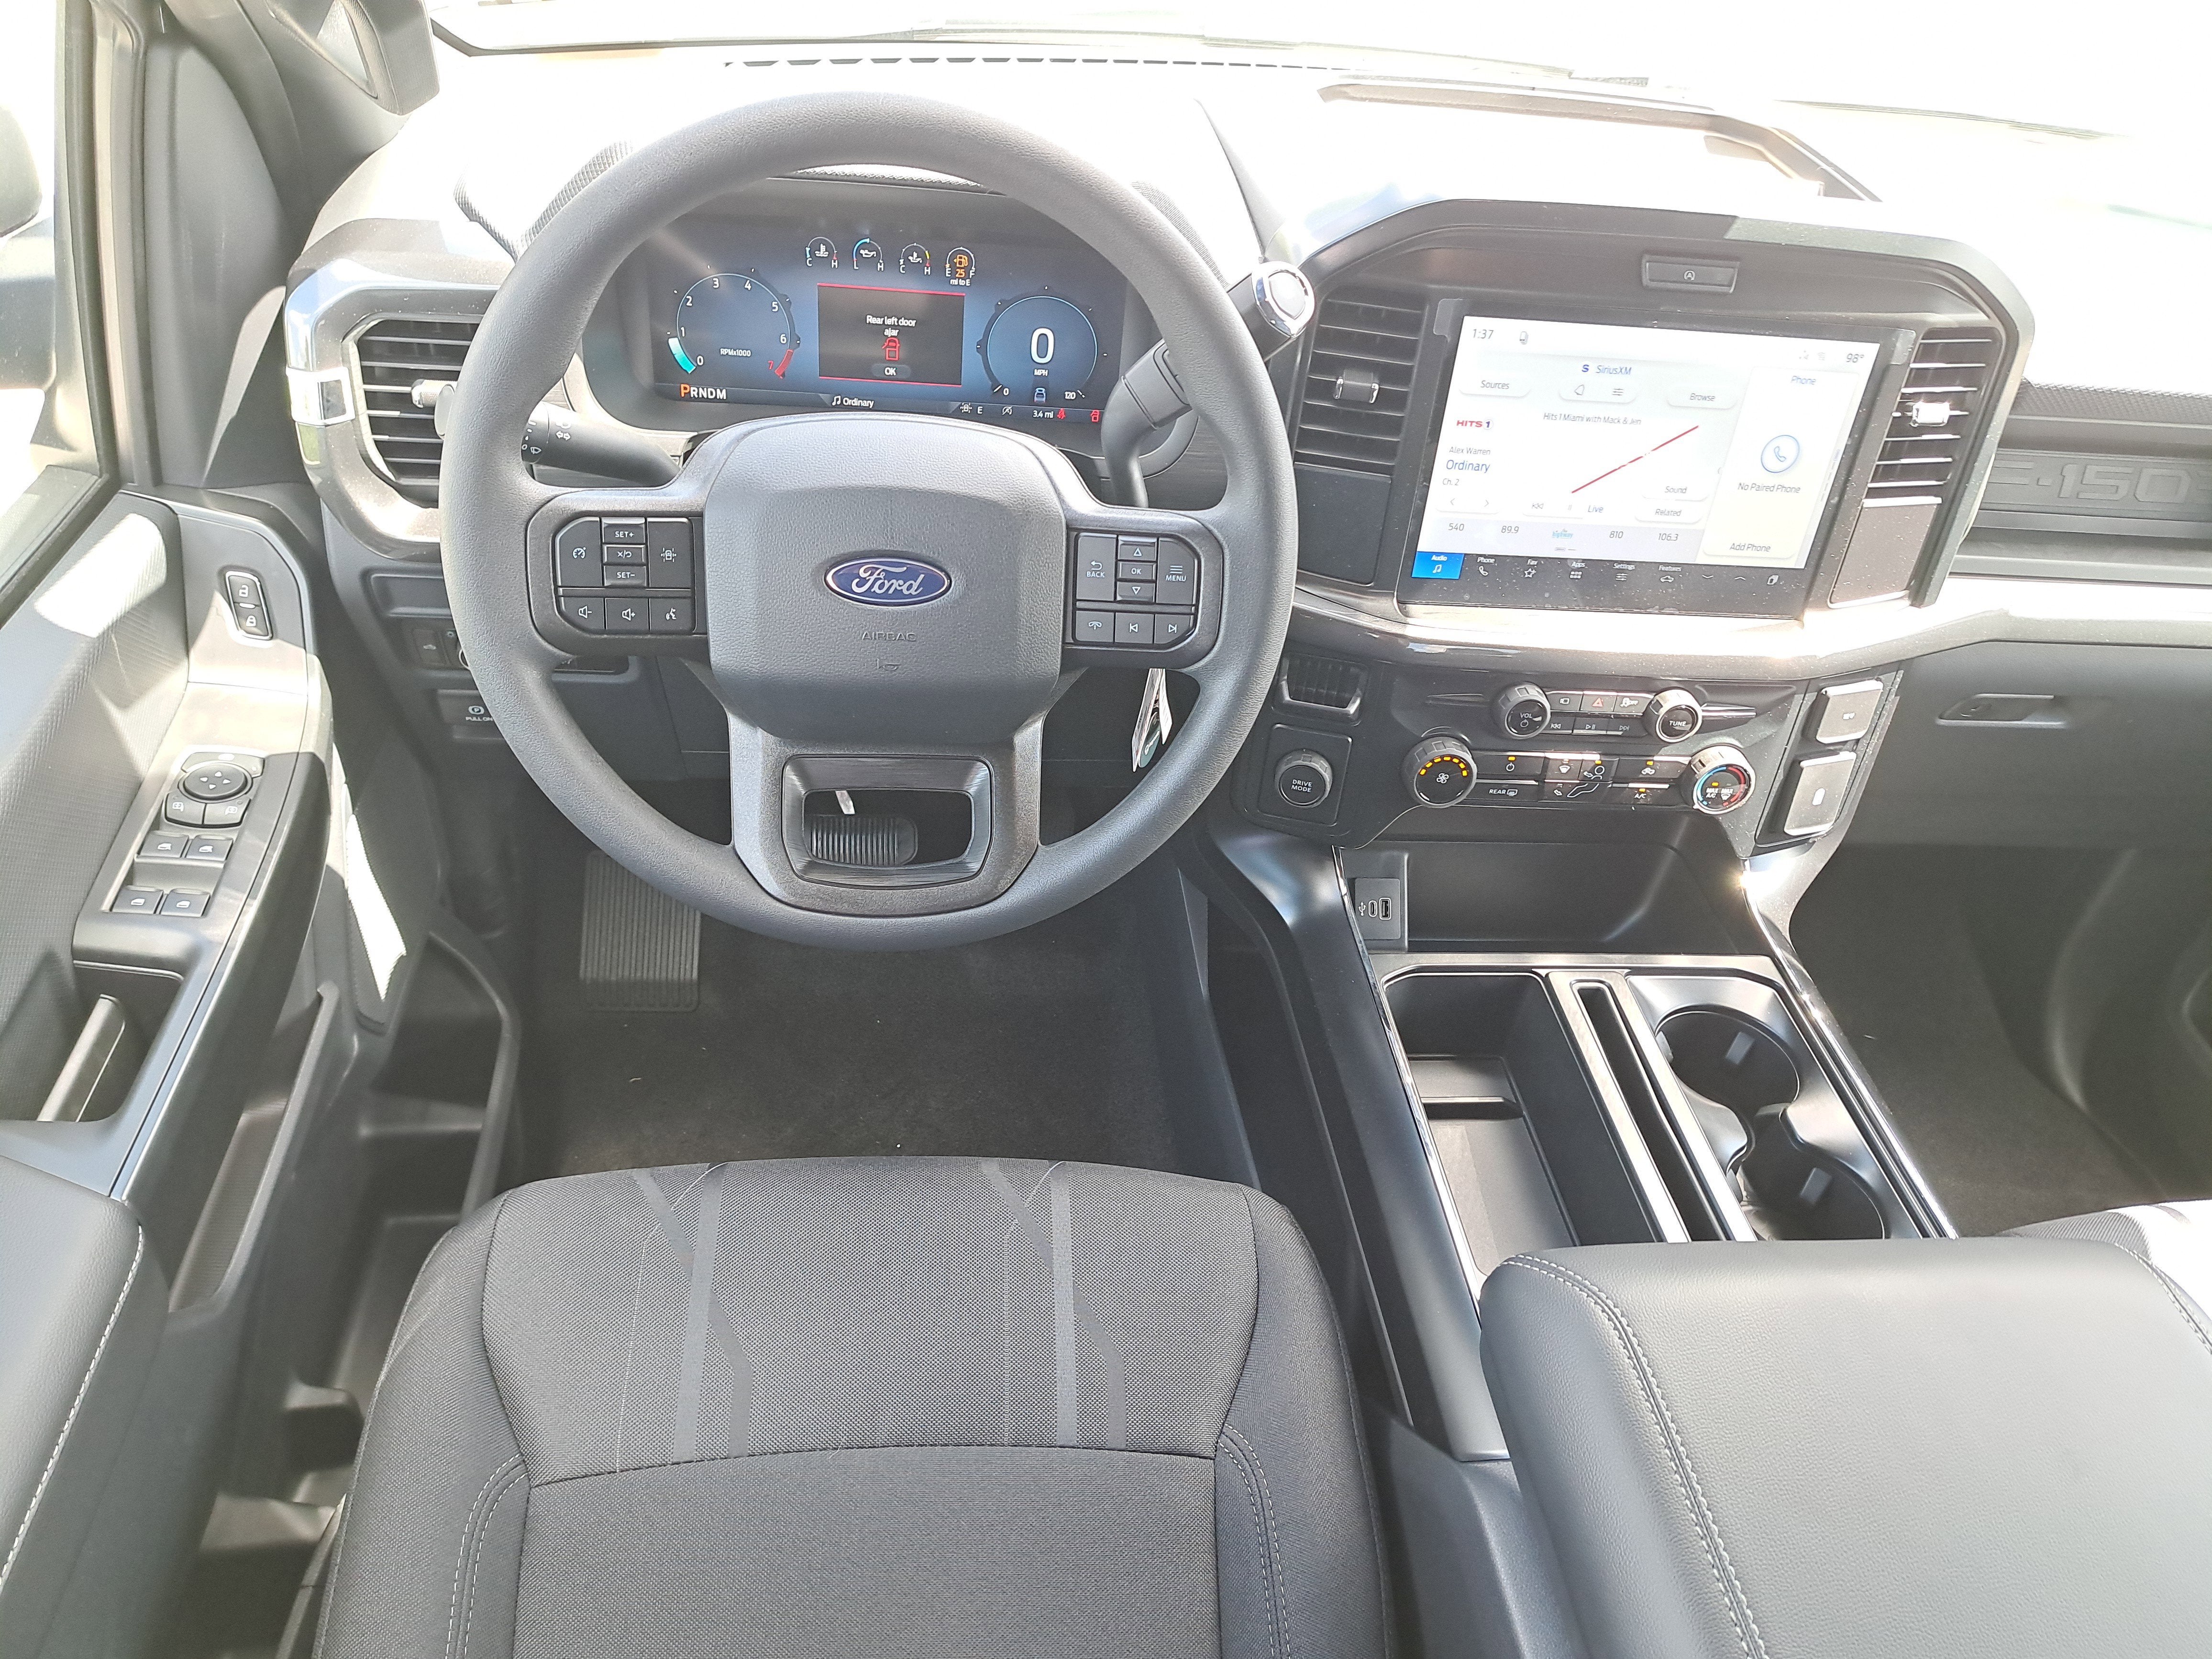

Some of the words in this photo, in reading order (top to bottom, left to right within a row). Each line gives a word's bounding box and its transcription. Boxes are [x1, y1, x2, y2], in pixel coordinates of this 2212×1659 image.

[807, 258, 812, 267] C
[832, 259, 838, 268] H
[853, 261, 859, 269] L
[877, 262, 884, 271] H
[899, 265, 906, 273] C
[924, 266, 930, 275] H
[946, 268, 951, 277] E
[955, 269, 965, 278] 25
[713, 278, 719, 288] 3
[744, 280, 752, 290] 4
[686, 296, 693, 306] 2
[772, 302, 778, 311] 5
[866, 315, 884, 325] Rear
[885, 317, 898, 326] left
[899, 317, 917, 327] door
[681, 327, 685, 336] 1
[884, 328, 899, 337] ajar
[1472, 328, 1494, 339] 1:37
[779, 334, 787, 344] 6
[1030, 327, 1055, 364] 0
[697, 356, 704, 365] 0
[768, 361, 774, 370] 7
[885, 367, 896, 376] OK
[1596, 365, 1632, 376] SiriusXM
[1791, 375, 1816, 385] Phone
[1481, 380, 1510, 390] Sources
[1003, 387, 1009, 396] 0
[1064, 391, 1076, 399] 120
[1690, 392, 1715, 401] Browse
[843, 397, 874, 409] Ordinary
[977, 406, 983, 414] E
[1032, 410, 1043, 418] 3.4
[1543, 412, 1557, 420] Hits
[1456, 420, 1482, 428] HITS
[1485, 420, 1491, 429] 1
[1449, 446, 1464, 454] Alex
[1466, 447, 1491, 455] Warren
[1446, 459, 1491, 473] Ordinary
[1665, 485, 1687, 494] Sound
[1737, 482, 1748, 491] No
[1750, 483, 1774, 492] Paired
[1776, 484, 1801, 494] Phone
[1588, 505, 1604, 513] Live
[1655, 509, 1681, 517] Related
[1448, 523, 1465, 531] 540
[1501, 525, 1520, 534] 89.9
[1609, 531, 1624, 539] 810
[1658, 532, 1679, 542] 106.3
[1729, 542, 1745, 551] Add
[1747, 543, 1771, 552] Phone
[1613, 563, 1636, 571] Settings
[852, 564, 925, 596] Ford
[862, 630, 917, 642] AIRBAG
[1292, 779, 1312, 787] DRIVE
[1291, 785, 1312, 793] MODE
